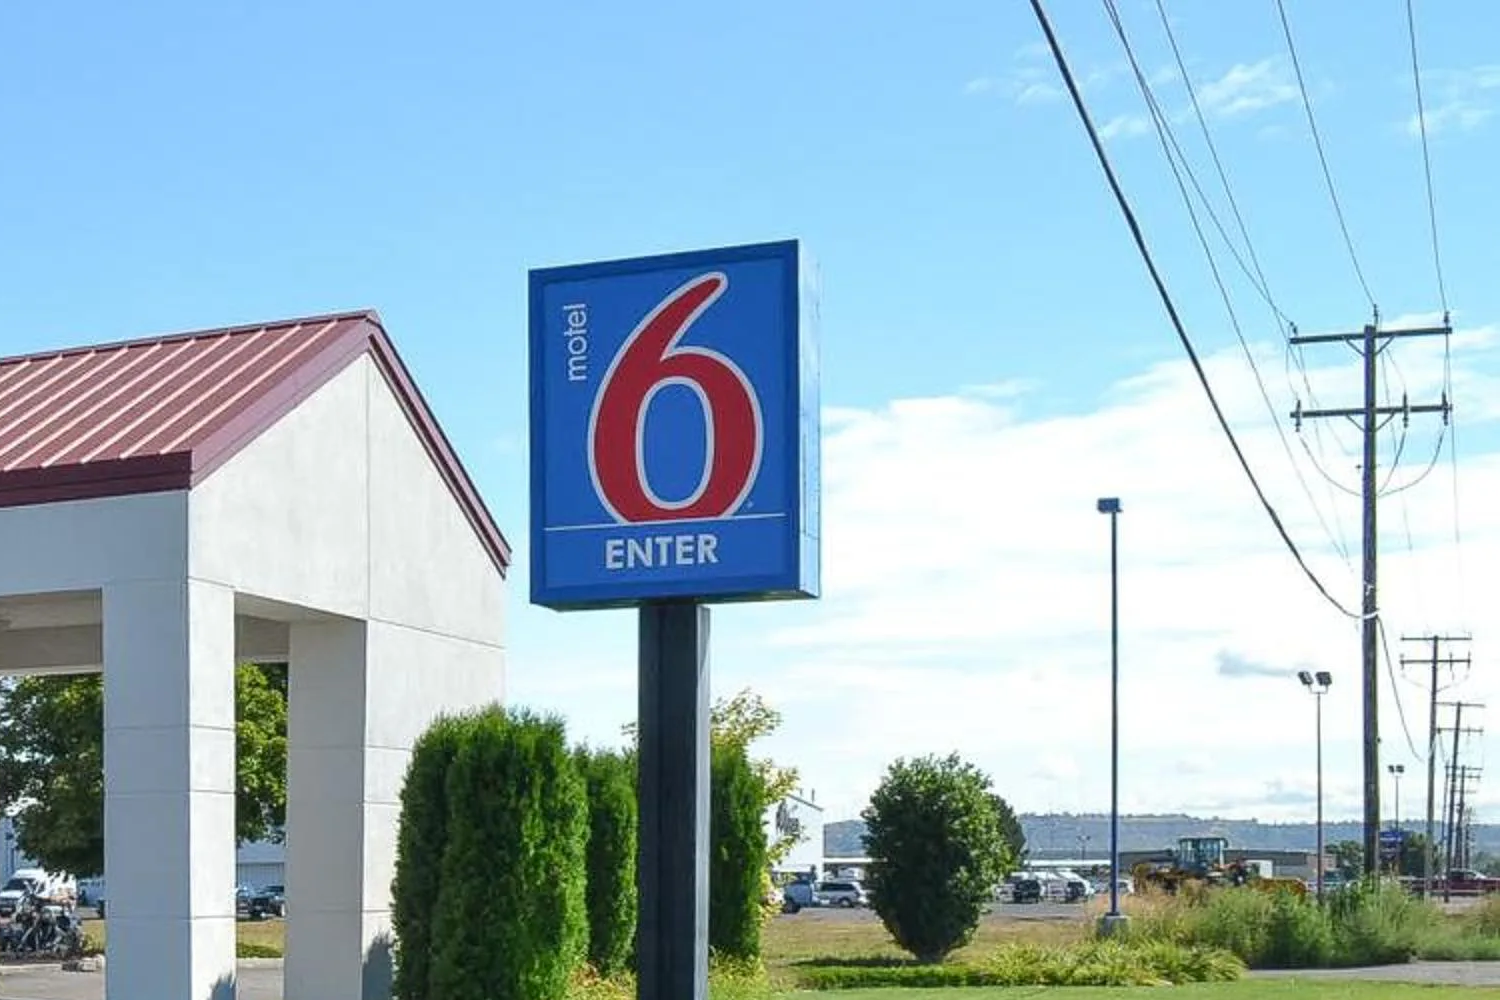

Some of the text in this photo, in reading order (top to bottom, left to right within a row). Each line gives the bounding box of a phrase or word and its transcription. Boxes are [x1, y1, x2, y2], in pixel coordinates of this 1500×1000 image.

[563, 303, 587, 381] motel
[587, 271, 764, 524] 6
[605, 533, 719, 569] ENTER
